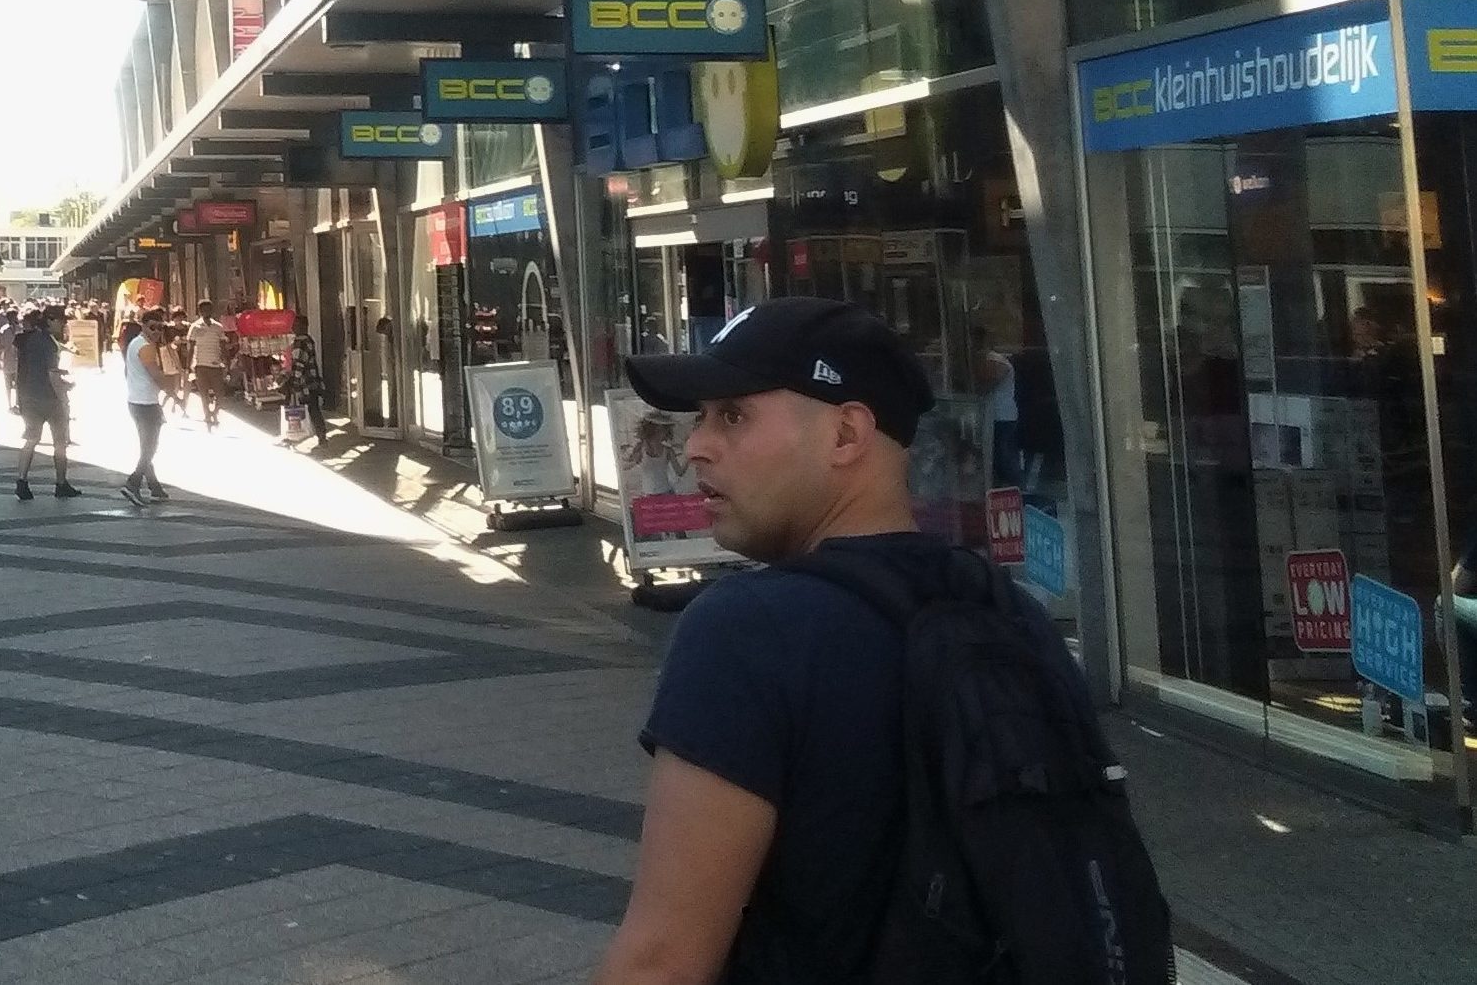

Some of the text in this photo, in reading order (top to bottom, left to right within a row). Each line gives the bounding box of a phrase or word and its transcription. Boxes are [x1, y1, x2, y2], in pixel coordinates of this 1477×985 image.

[588, 0, 709, 29] BCC
[438, 79, 529, 100] BCC
[350, 125, 422, 143] BCC
[500, 394, 535, 420] 8,9
[1290, 561, 1343, 578] EVERYDAY
[1292, 578, 1346, 616] LOW
[1297, 621, 1351, 640] PRICING
[1356, 603, 1417, 666] HIGH
